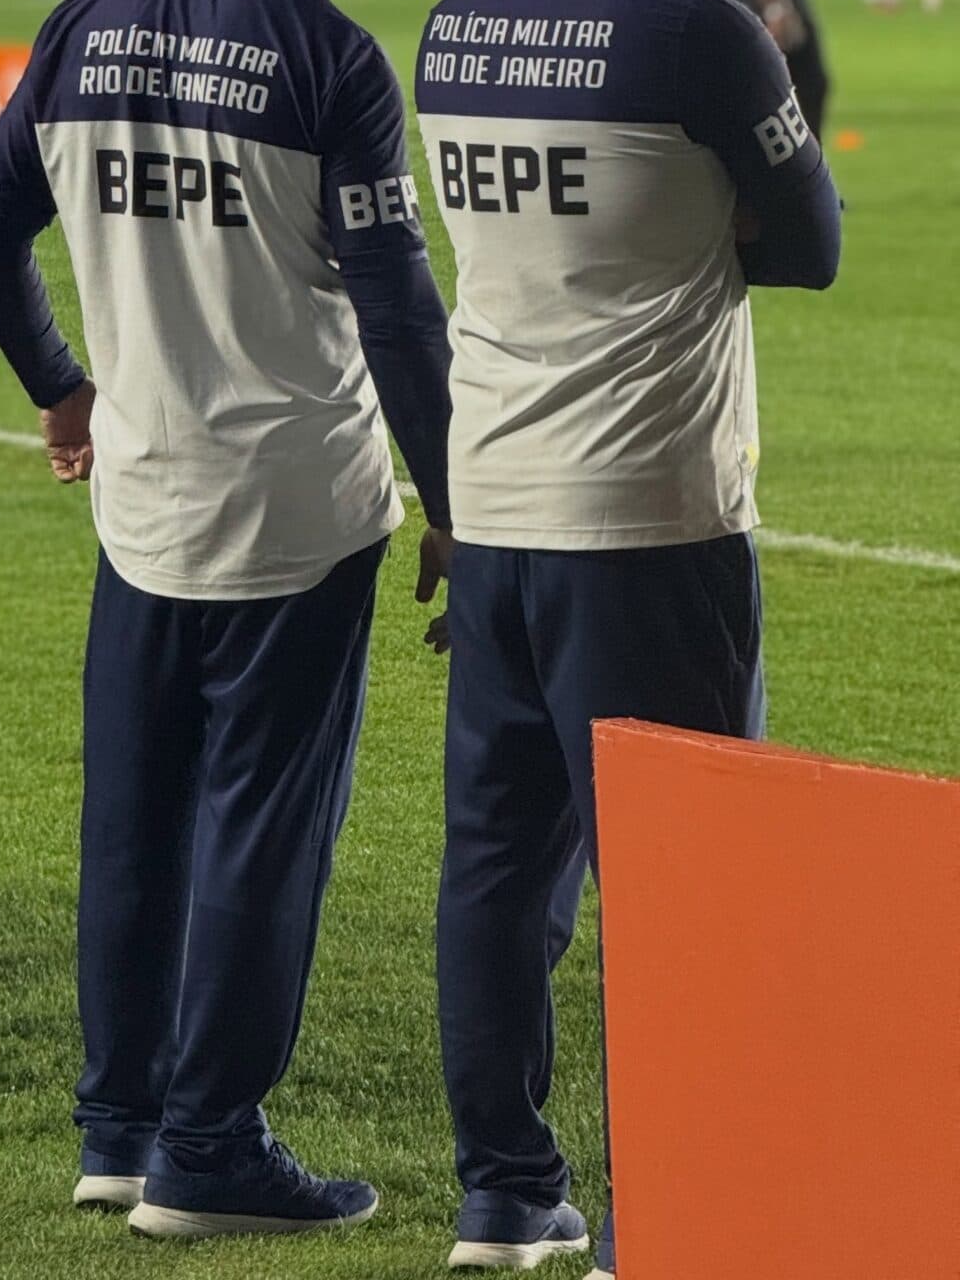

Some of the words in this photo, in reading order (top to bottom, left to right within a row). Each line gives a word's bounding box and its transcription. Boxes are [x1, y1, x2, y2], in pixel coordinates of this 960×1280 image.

[85, 24, 176, 58] POLÍCIA
[179, 36, 279, 77] MILITAR
[429, 11, 507, 46] POLÍCIA
[511, 20, 614, 48] MILITAR
[79, 65, 121, 96] RIO
[126, 68, 162, 96] DE
[163, 72, 269, 115] JANEIRO
[424, 52, 456, 83] RIO
[460, 55, 488, 85] DE
[495, 57, 607, 88] JANEIRO
[95, 149, 248, 228] BEPE
[439, 140, 589, 216] BEPE
